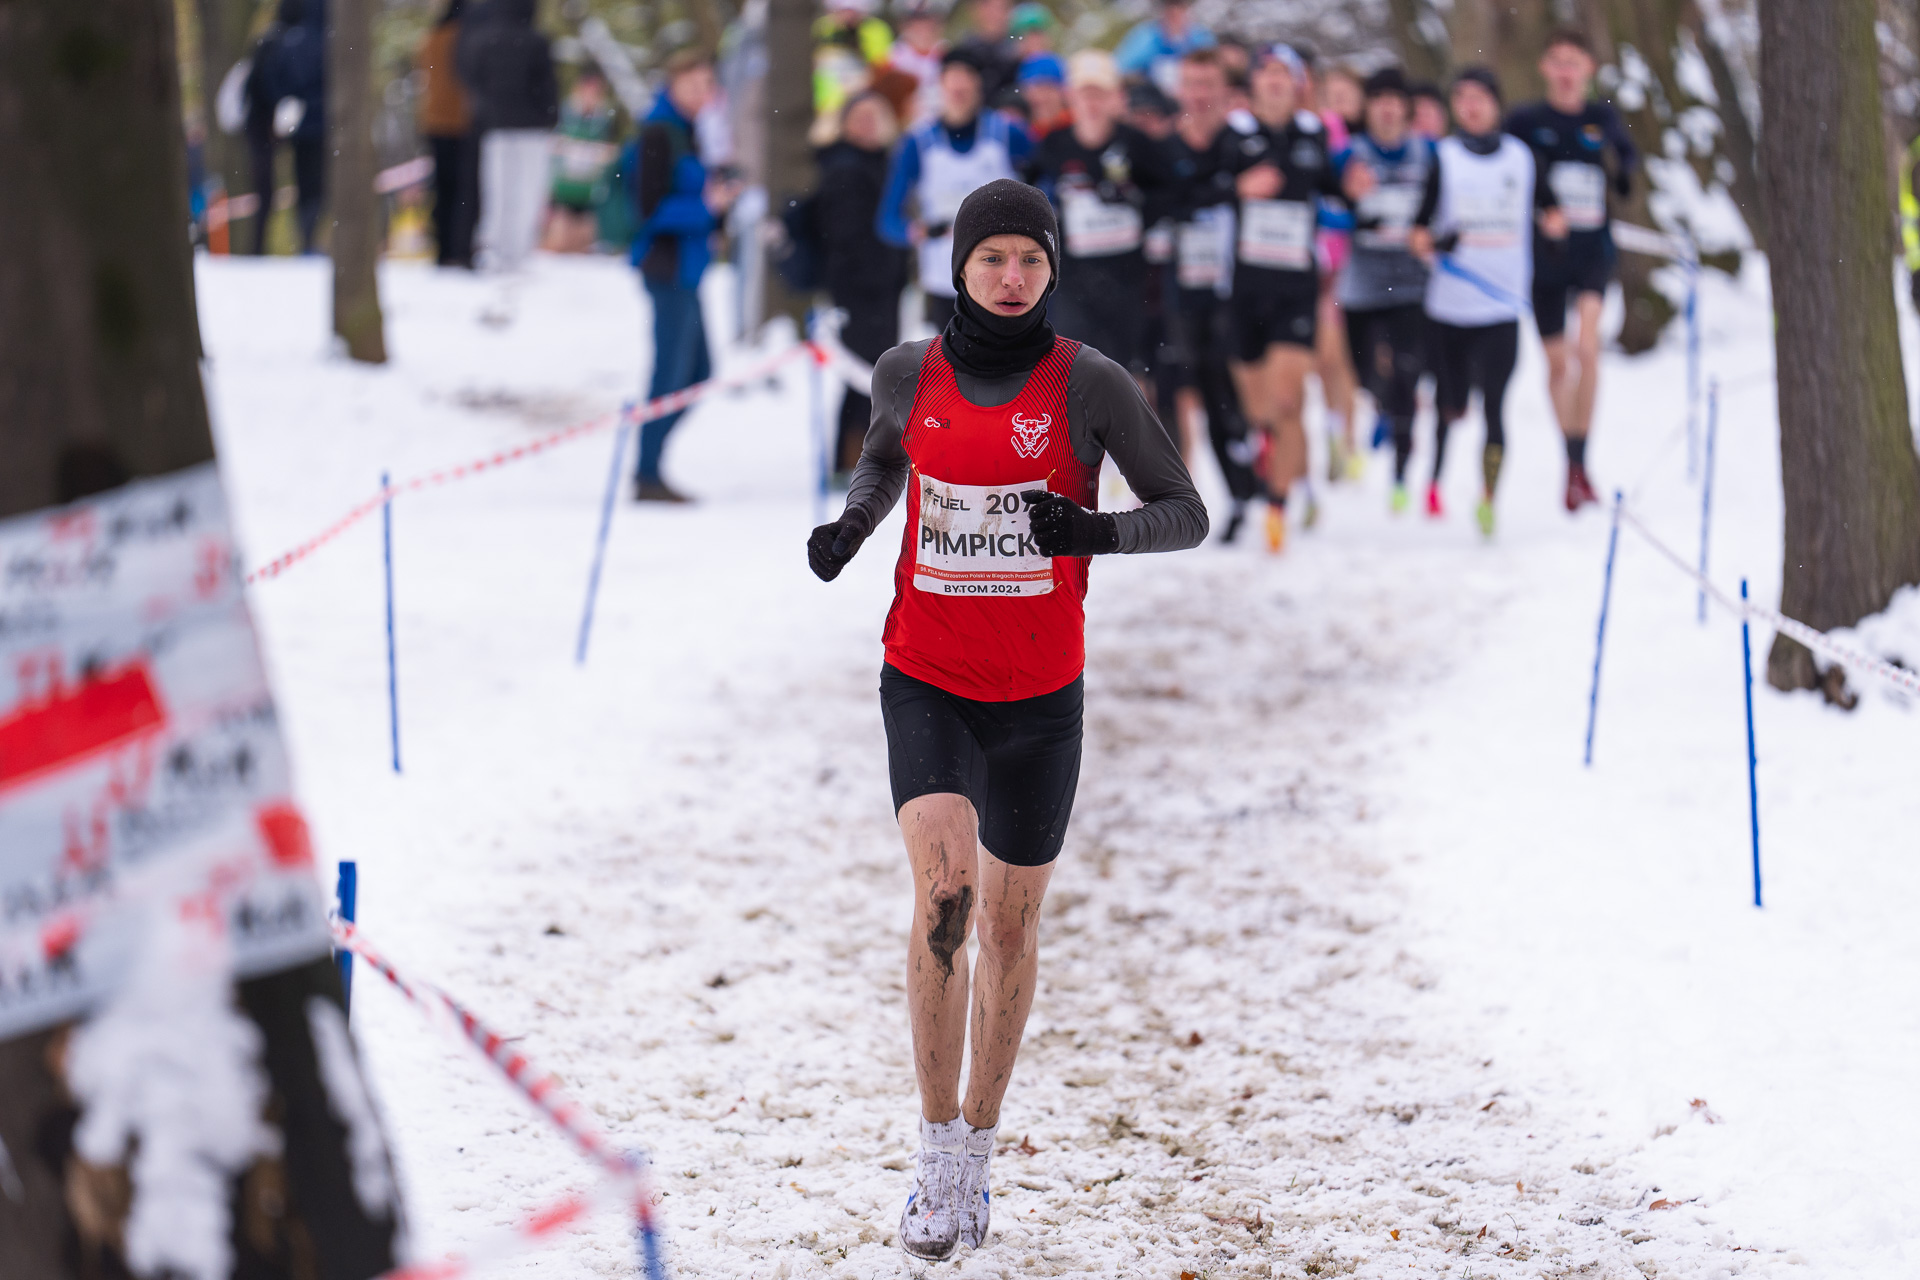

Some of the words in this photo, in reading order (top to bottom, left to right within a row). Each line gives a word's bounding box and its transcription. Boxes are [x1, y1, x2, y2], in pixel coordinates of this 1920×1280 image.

[937, 571, 969, 579] Mistrzostwa
[944, 584, 988, 593] BYTOM
[990, 584, 1022, 594] 2024
